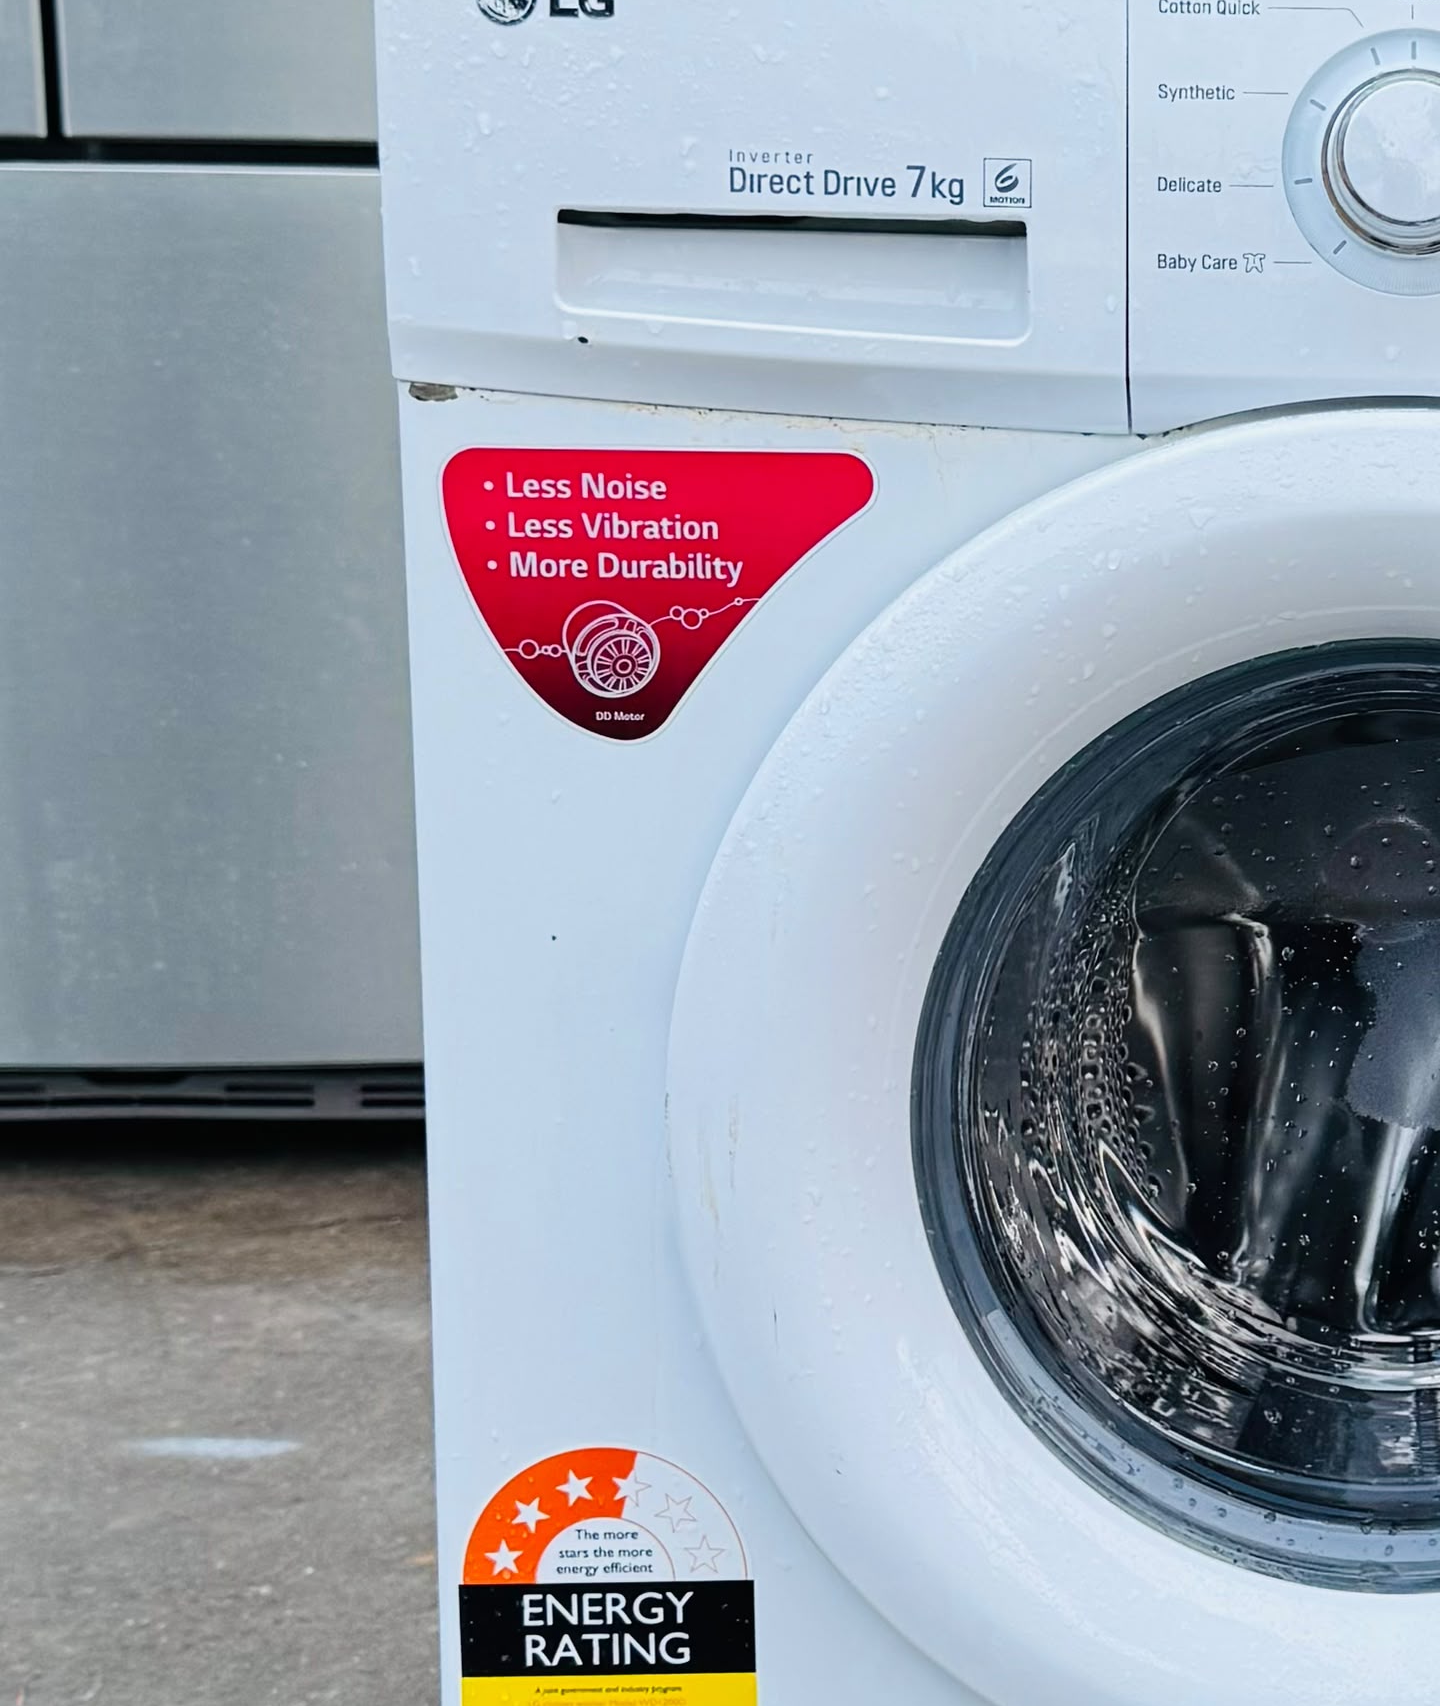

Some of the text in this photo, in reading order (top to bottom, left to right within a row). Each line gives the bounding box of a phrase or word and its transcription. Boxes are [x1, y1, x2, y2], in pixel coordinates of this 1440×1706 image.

[1158, 83, 1235, 105] Synthetic
[729, 148, 814, 164] Inverter
[729, 167, 815, 196] Direct
[823, 169, 896, 197] Drive
[1157, 176, 1222, 194] Delicate
[989, 196, 1026, 205] MOTION
[1157, 253, 1238, 273] Baby Care
[507, 472, 667, 500] Less Noise
[508, 512, 719, 540] Less Vibration
[510, 552, 743, 587] More Durability
[596, 711, 645, 721] DD Motor
[575, 1529, 639, 1541] The more
[559, 1546, 653, 1559] stars the more
[556, 1562, 653, 1577] energy efficient
[522, 1592, 694, 1627] ENERGY
[525, 1632, 691, 1667] RATING
